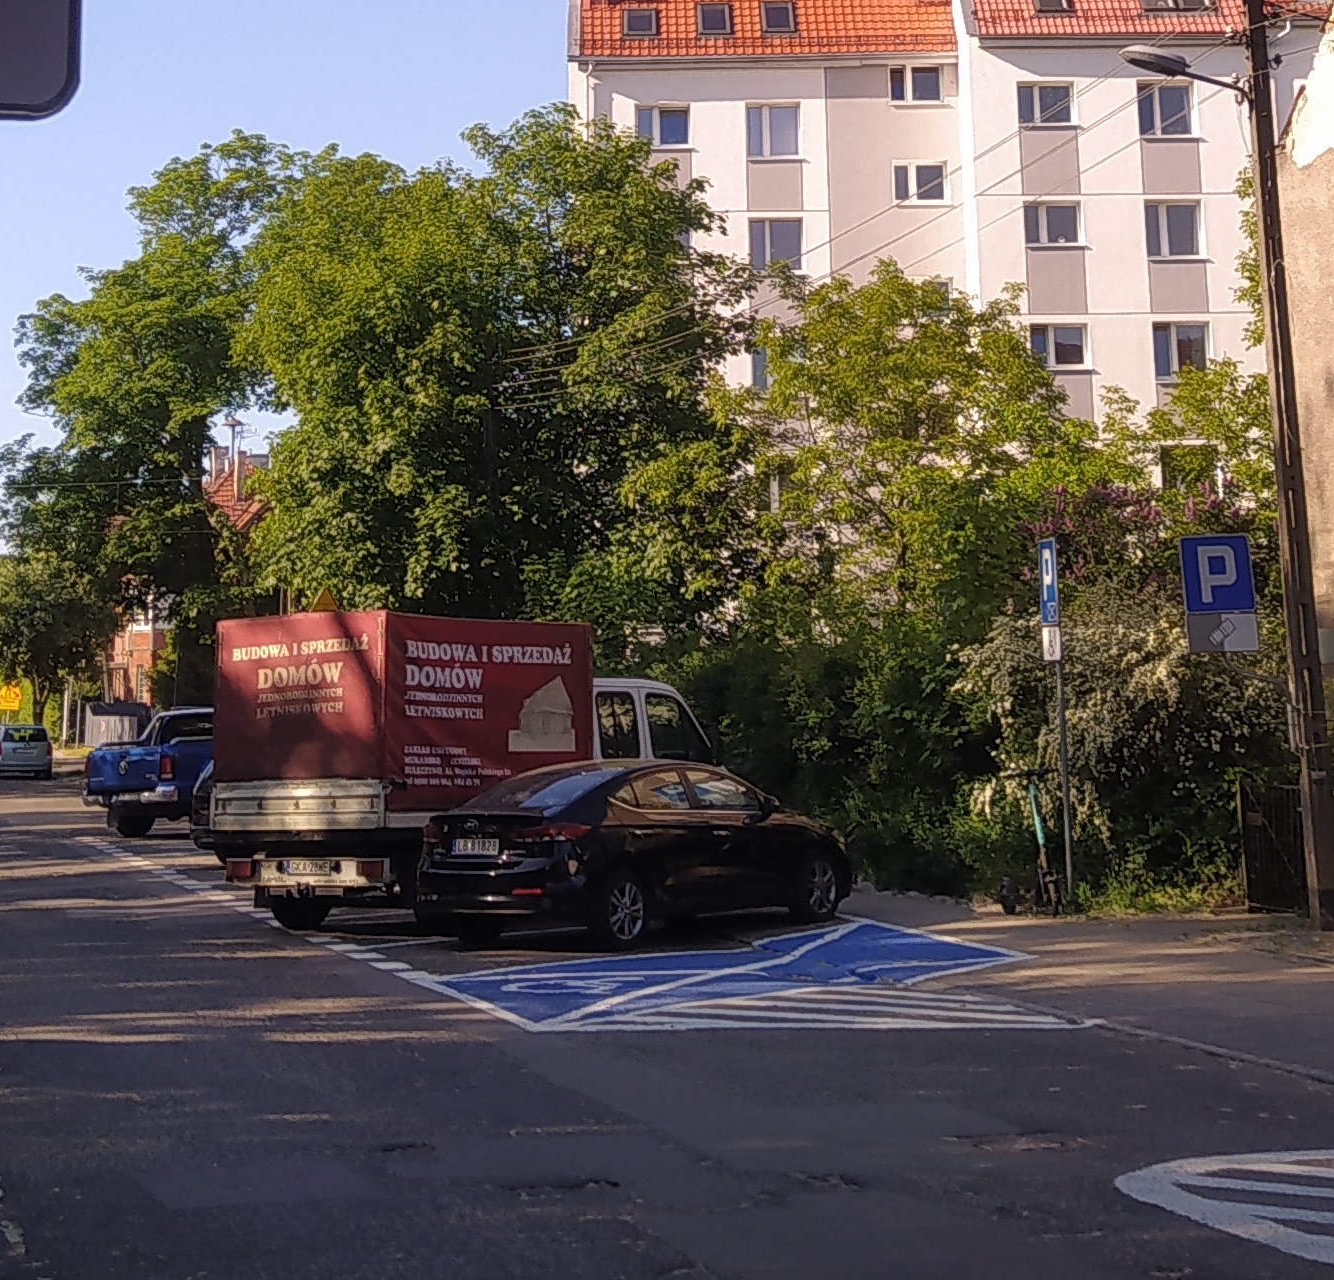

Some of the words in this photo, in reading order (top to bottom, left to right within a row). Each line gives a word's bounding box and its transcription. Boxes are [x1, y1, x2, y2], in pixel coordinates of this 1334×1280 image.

[1042, 548, 1052, 601] P
[1196, 545, 1237, 604] P
[232, 643, 290, 662] BUDOWA
[292, 642, 298, 656] I
[300, 632, 369, 656] SPRZEDAŻ
[405, 639, 478, 663] BUDOWA
[482, 645, 489, 663] I
[492, 642, 572, 665] SPRZEDAŻ
[257, 657, 343, 690] DOMÓW
[405, 663, 483, 690] DOMÓW
[256, 702, 343, 719] LETNISKOWYCH
[404, 704, 483, 720] LETNISKOWYCH
